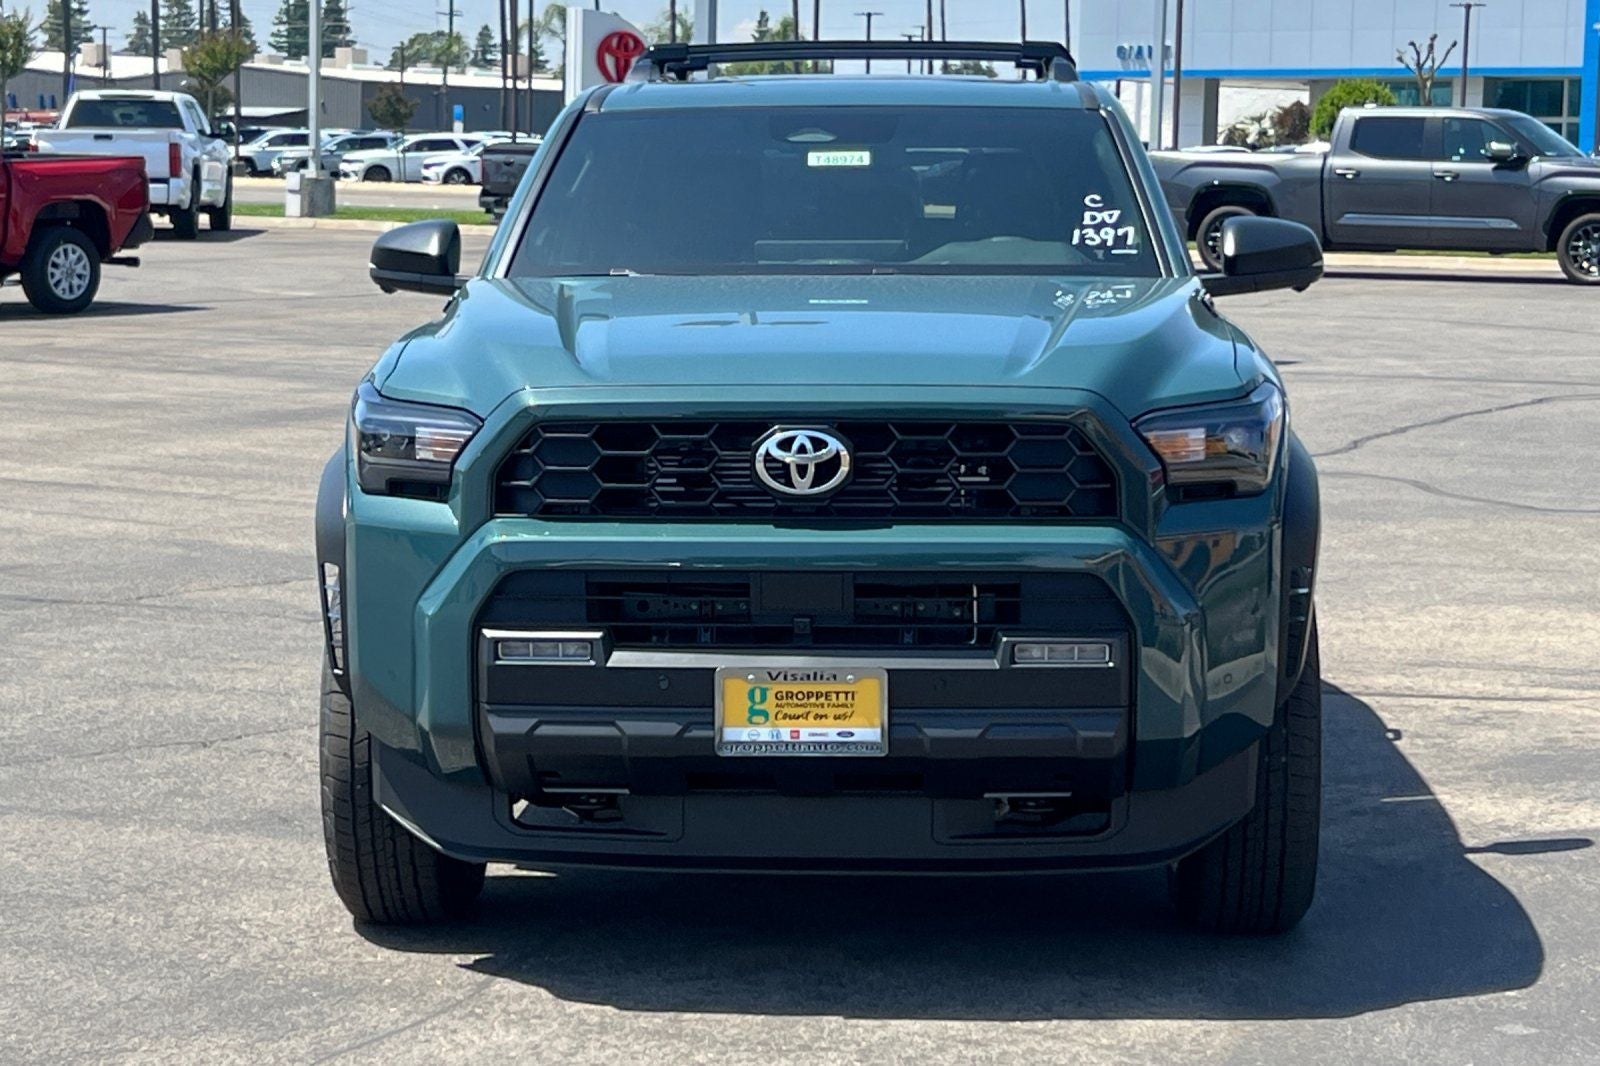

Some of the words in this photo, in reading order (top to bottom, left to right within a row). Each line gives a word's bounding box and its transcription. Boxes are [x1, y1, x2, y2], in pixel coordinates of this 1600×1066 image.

[816, 155, 864, 164] T48974
[1072, 226, 1135, 246] 1397
[767, 671, 837, 681] Visalia
[775, 690, 854, 701] GROPPETTI
[775, 710, 809, 721] Count
[813, 712, 828, 721] on
